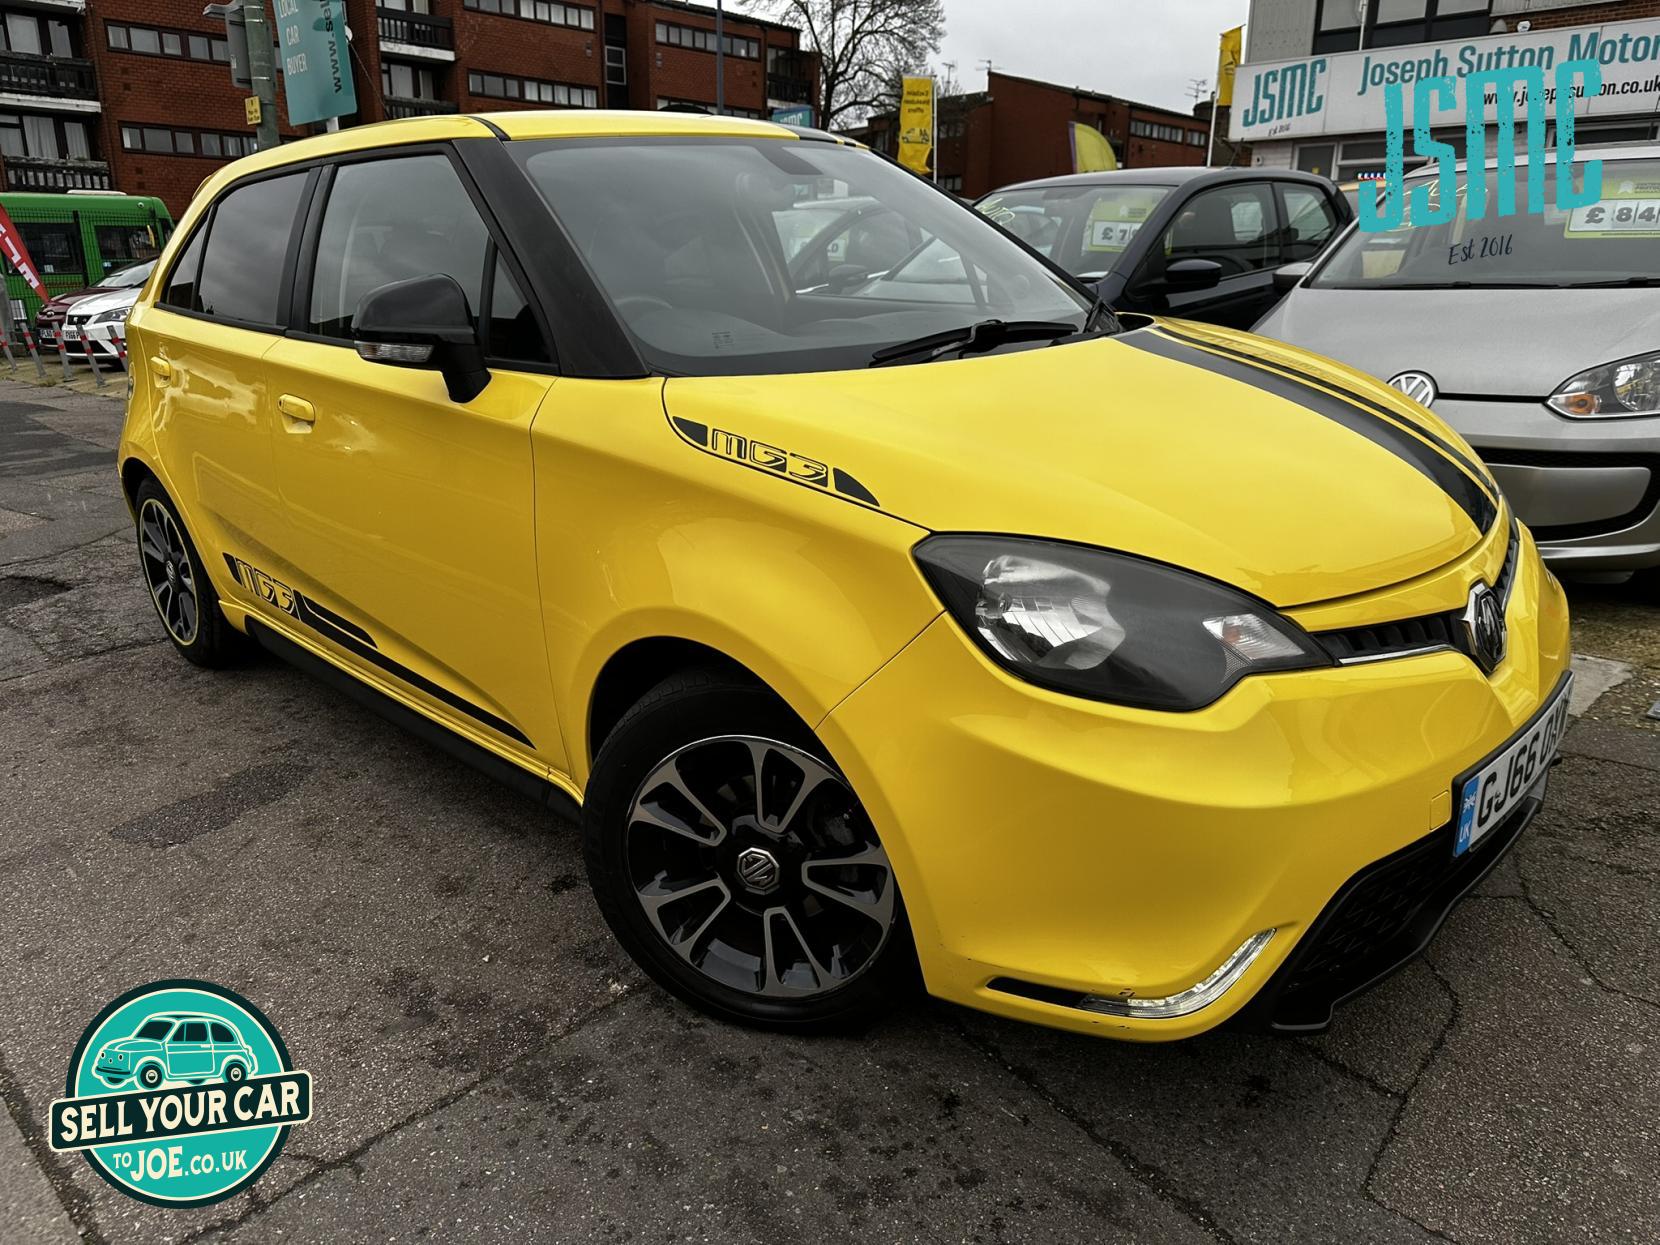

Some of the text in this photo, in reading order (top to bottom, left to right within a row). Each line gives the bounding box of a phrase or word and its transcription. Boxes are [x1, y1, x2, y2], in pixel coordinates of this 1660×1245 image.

[286, 25, 300, 46] CAR
[287, 53, 308, 76] BUYER
[1357, 49, 1449, 96] Joseph
[1457, 45, 1555, 78] Sutton
[1243, 58, 1327, 127] JSMC
[1477, 730, 1541, 829] GJ66
